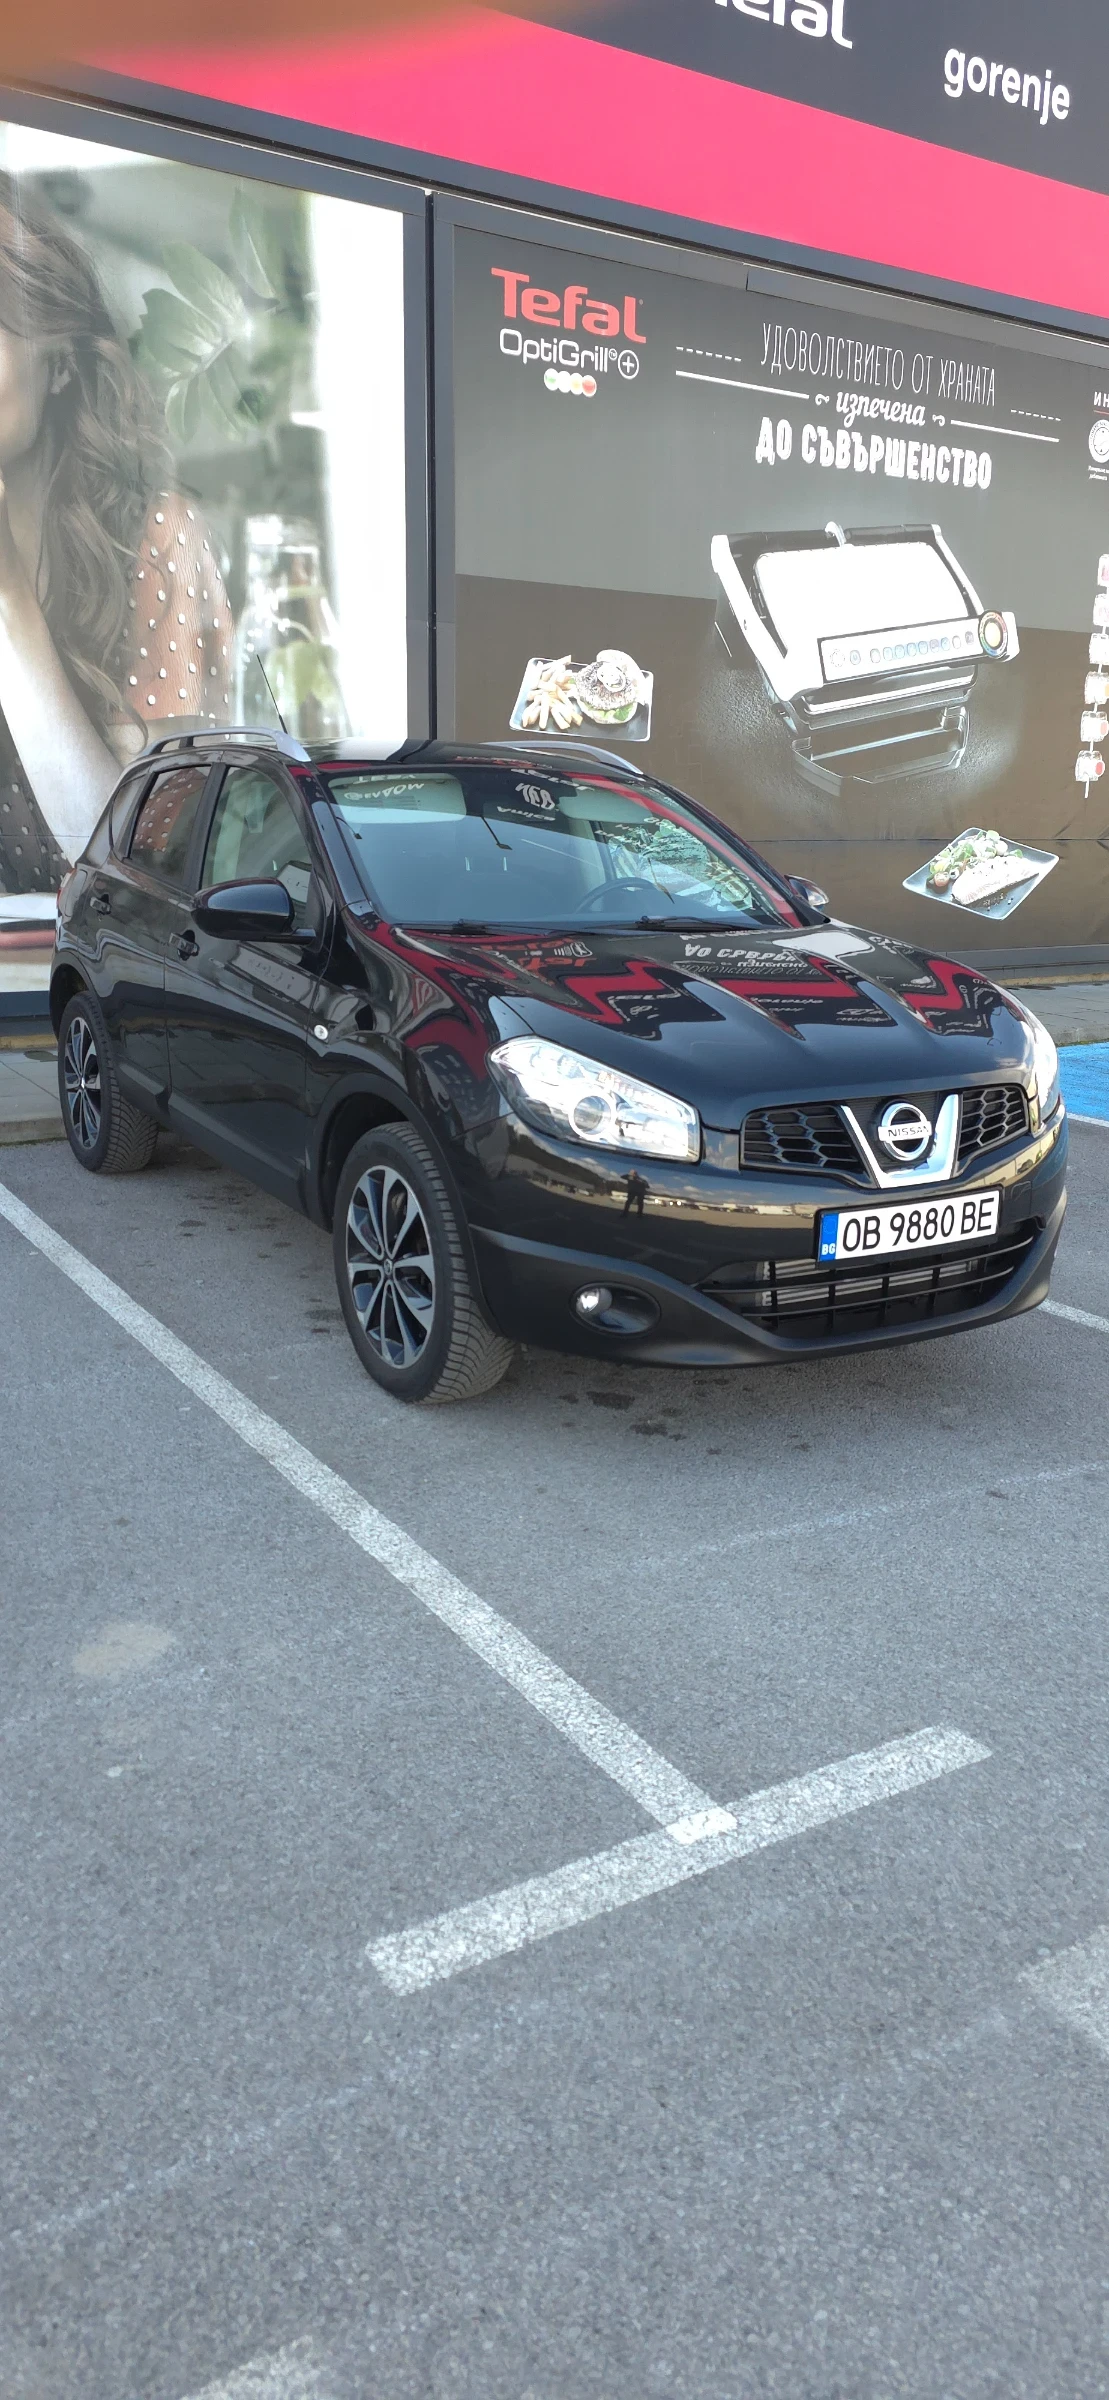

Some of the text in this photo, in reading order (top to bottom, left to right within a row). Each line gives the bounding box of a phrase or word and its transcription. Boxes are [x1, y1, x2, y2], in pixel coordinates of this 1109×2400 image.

[715, 0, 853, 49] efal
[943, 47, 1071, 126] gorenje
[491, 267, 647, 344] Tefal
[760, 322, 996, 407] УДОВОЛСТВИЕТО ОТ ХРАНАТА
[835, 391, 926, 428] изпечена
[755, 416, 993, 490] ДО СЪВЪРШЕНСТВО
[821, 1243, 836, 1255] BG
[843, 1197, 995, 1252] OB 9880 BE
